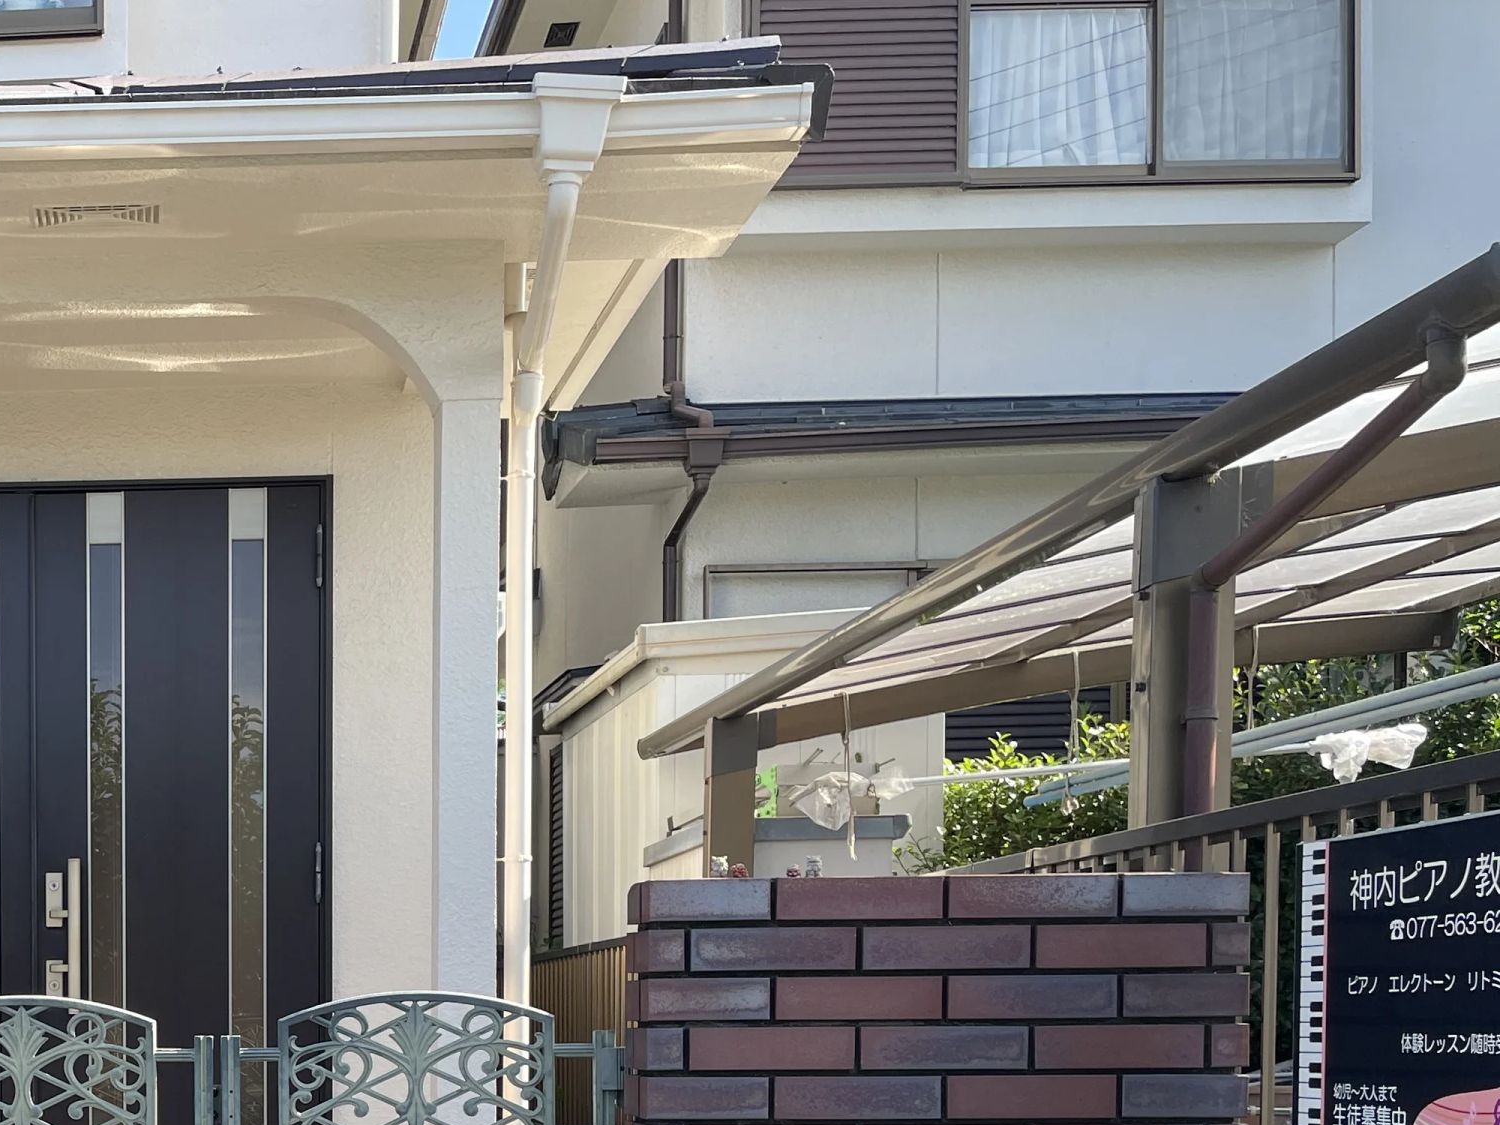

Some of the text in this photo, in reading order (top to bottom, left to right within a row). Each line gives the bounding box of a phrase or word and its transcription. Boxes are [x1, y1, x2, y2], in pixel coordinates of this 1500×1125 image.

[1350, 851, 1500, 911] 神内ピアノ教
[1348, 975, 1378, 995] ピアノ
[1388, 973, 1456, 993] エレクトーン
